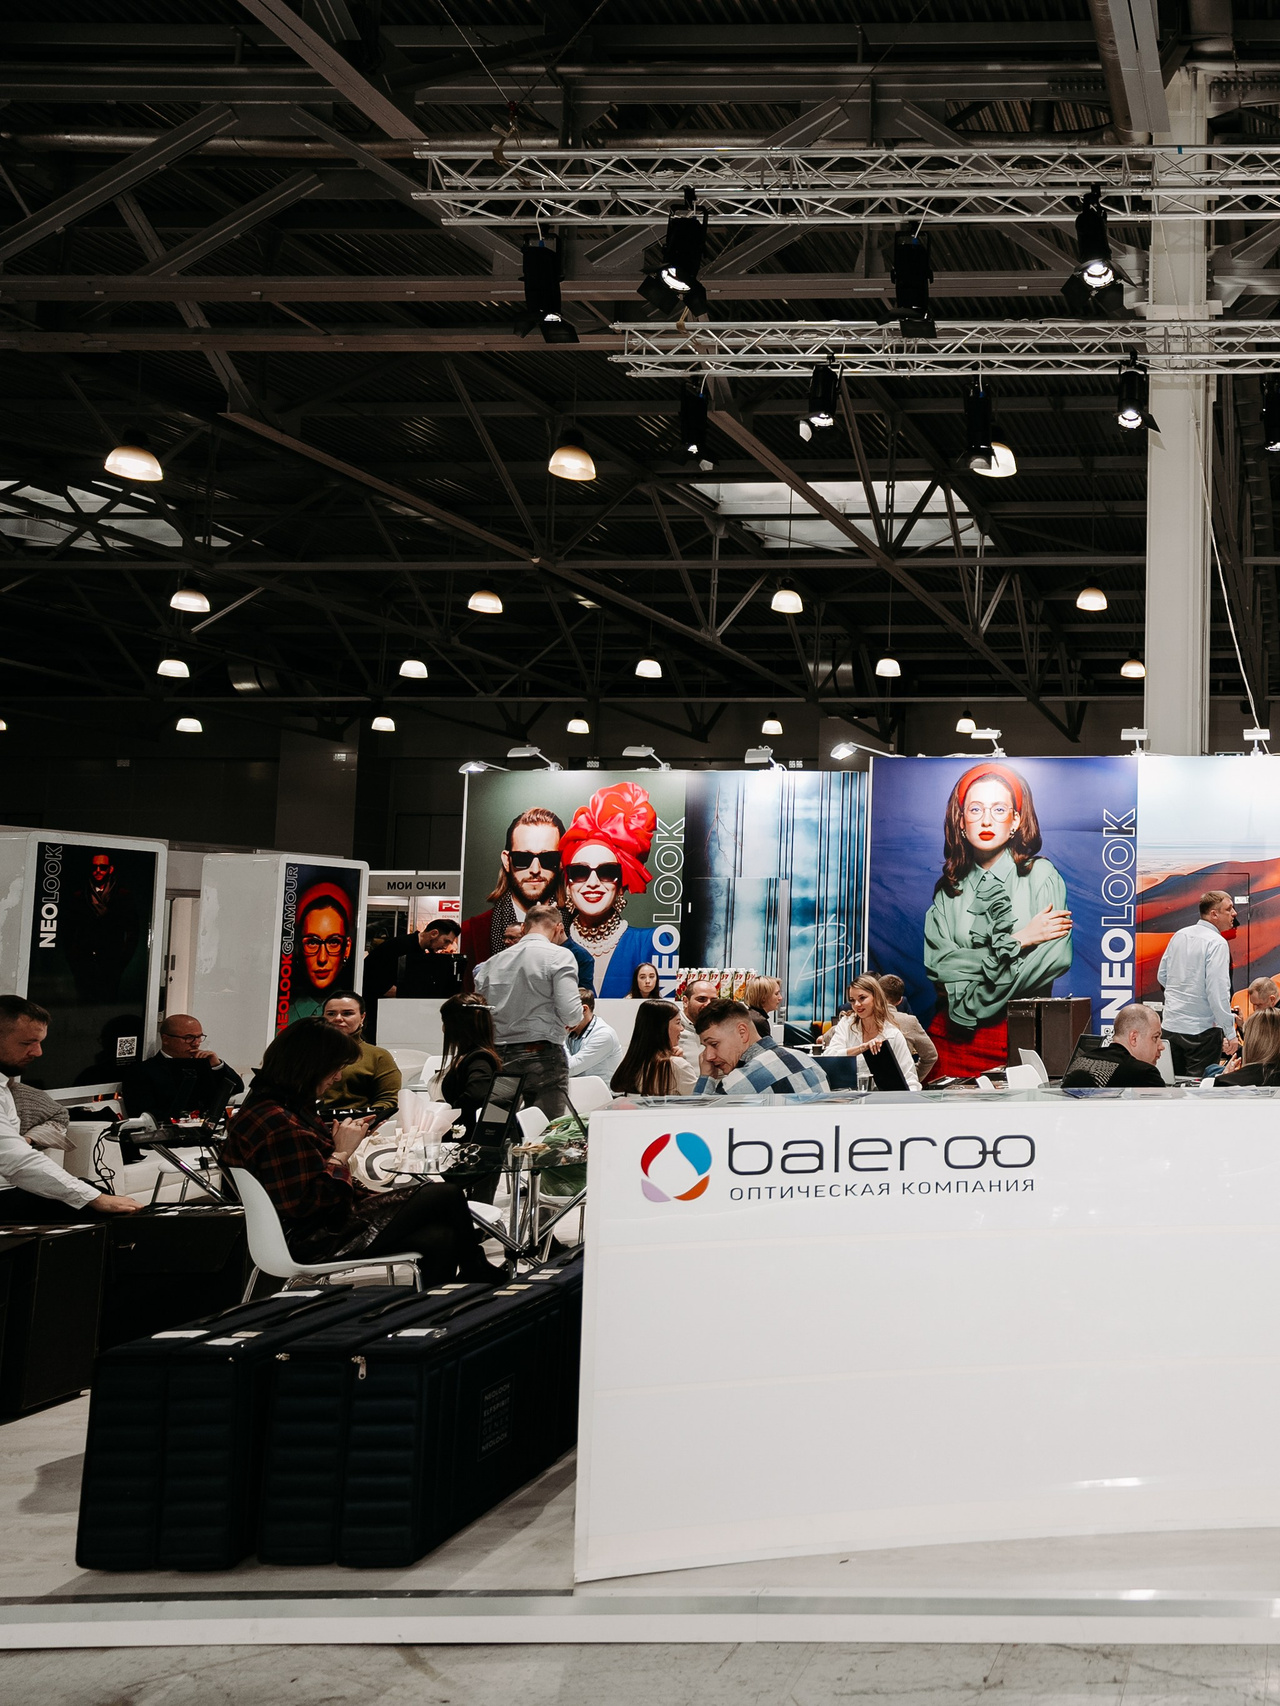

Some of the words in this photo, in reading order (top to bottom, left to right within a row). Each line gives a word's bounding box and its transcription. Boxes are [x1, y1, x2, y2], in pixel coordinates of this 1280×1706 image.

[39, 844, 63, 948] NEOLOOK
[386, 881, 413, 891] МОИ
[416, 881, 447, 891] ОЧКИ
[1101, 807, 1136, 1019] NEOLOOK
[727, 1125, 1036, 1176] baleroo
[729, 1182, 891, 1201] ОПТИЧЕСКАЯ
[901, 1178, 1036, 1196] КОМПАНИЯ
